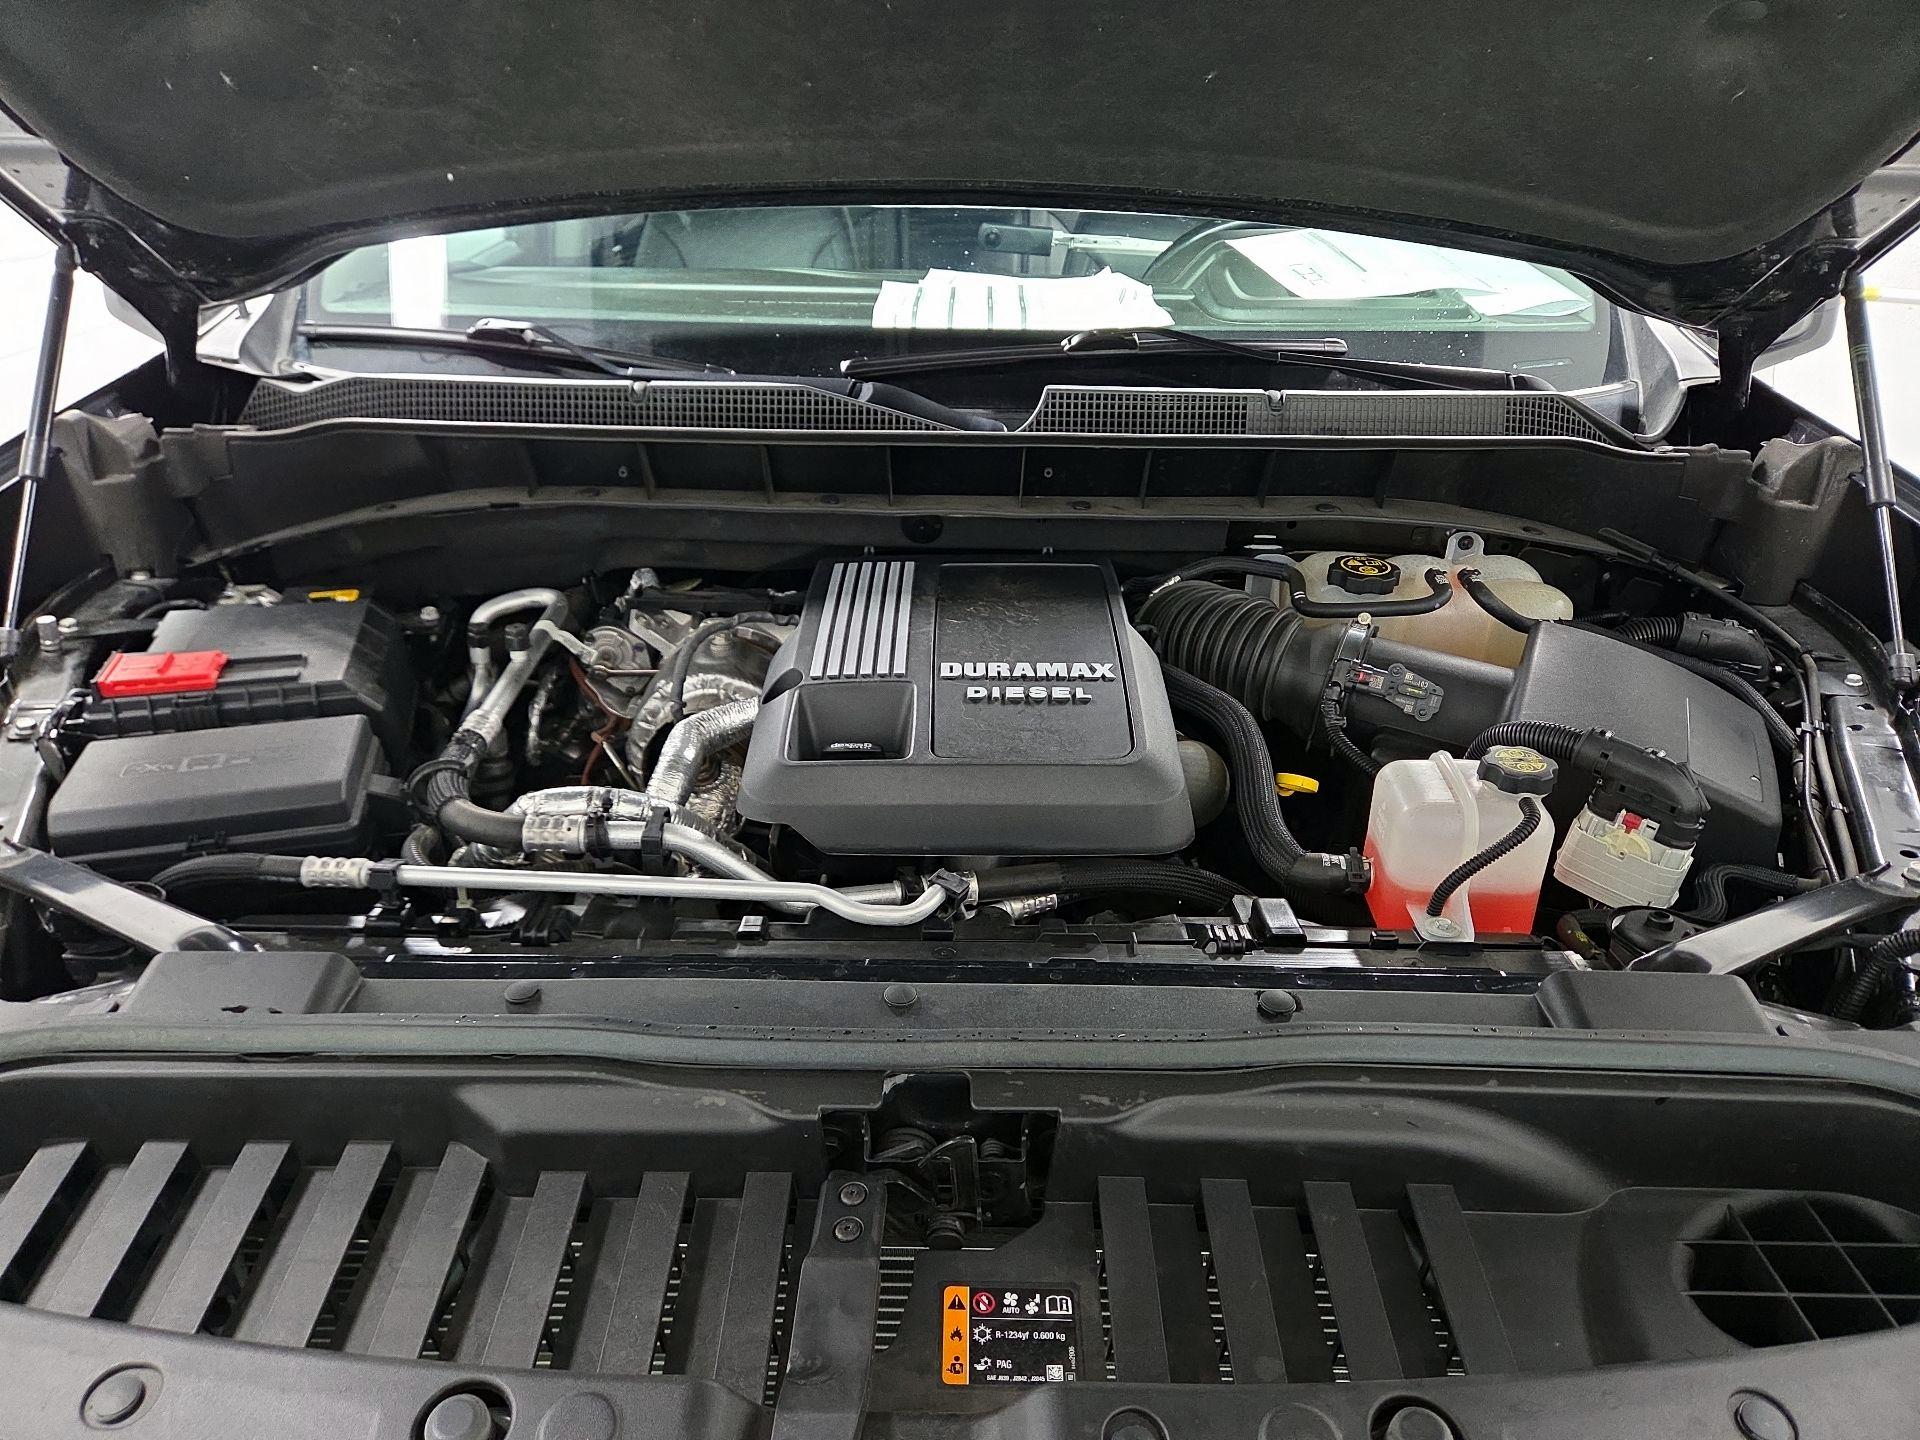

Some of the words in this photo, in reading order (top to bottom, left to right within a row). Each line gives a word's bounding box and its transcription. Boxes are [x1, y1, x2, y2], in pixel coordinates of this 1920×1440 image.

[940, 662, 1117, 681] DURAMAX
[966, 686, 1093, 702] DIESEL
[995, 1331, 1029, 1340] R-1234yf
[1056, 1332, 1066, 1341] kg
[996, 1360, 1012, 1369] PAG
